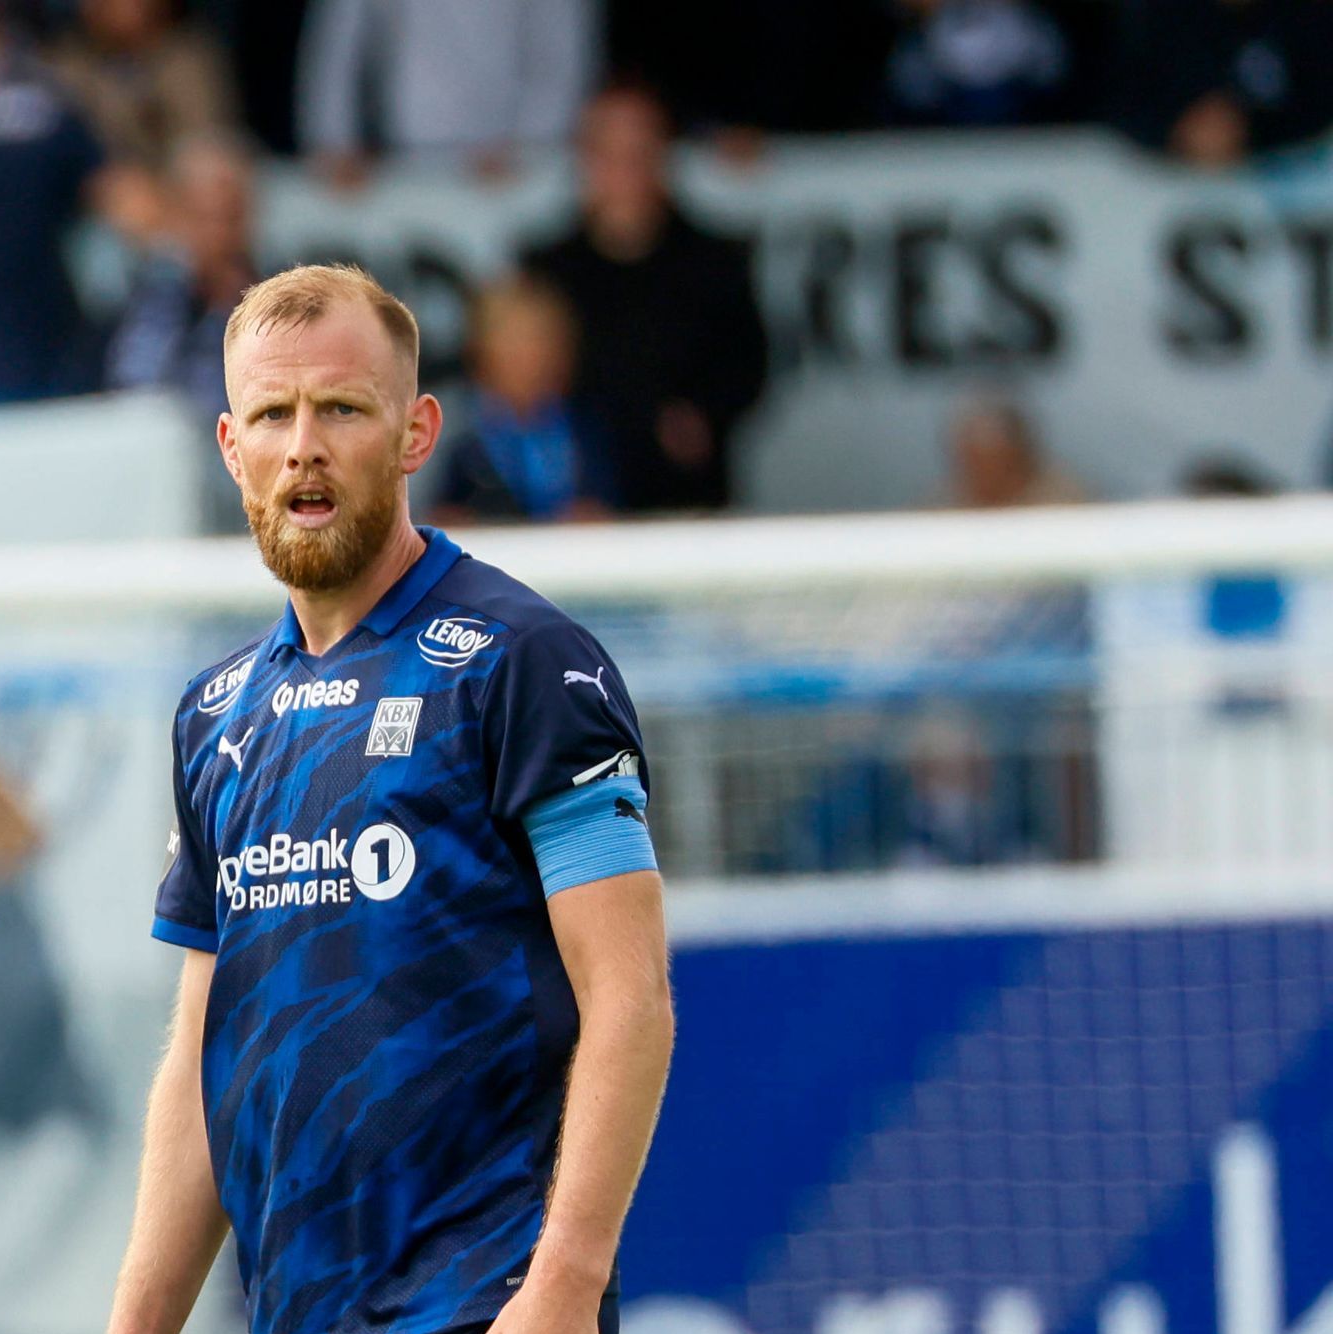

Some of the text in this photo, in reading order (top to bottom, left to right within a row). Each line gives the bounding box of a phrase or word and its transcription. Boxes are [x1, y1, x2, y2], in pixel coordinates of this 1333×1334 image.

[425, 618, 492, 652] LERØY
[202, 656, 256, 703] LERØ
[231, 878, 351, 911] ORDMØRE
